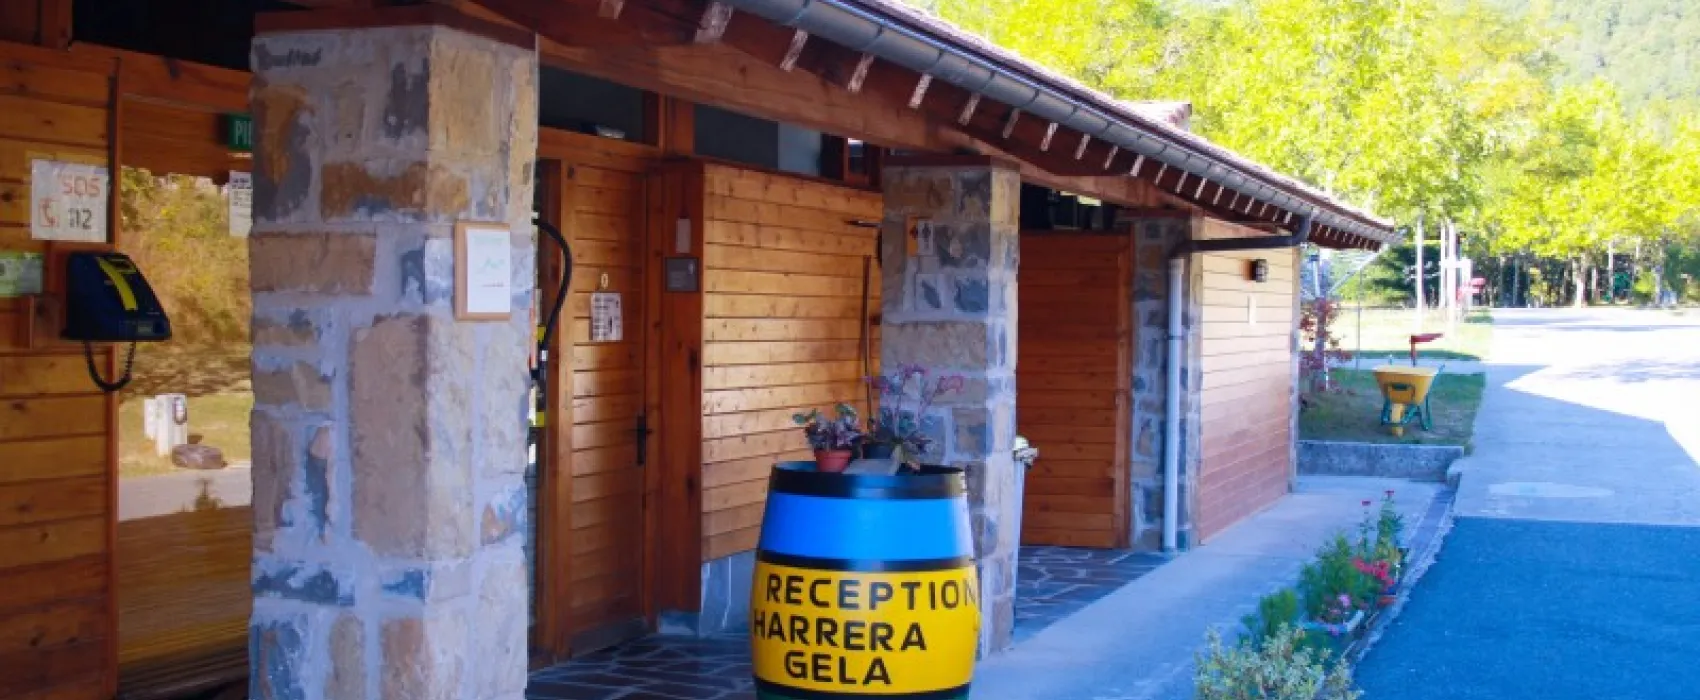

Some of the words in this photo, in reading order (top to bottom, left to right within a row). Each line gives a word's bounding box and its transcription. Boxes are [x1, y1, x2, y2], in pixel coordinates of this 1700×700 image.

[62, 174, 101, 198] SOS
[67, 207, 93, 230] 112
[766, 573, 977, 611] RECEPTION
[753, 608, 927, 652] HARRERA
[784, 651, 892, 685] GELA
